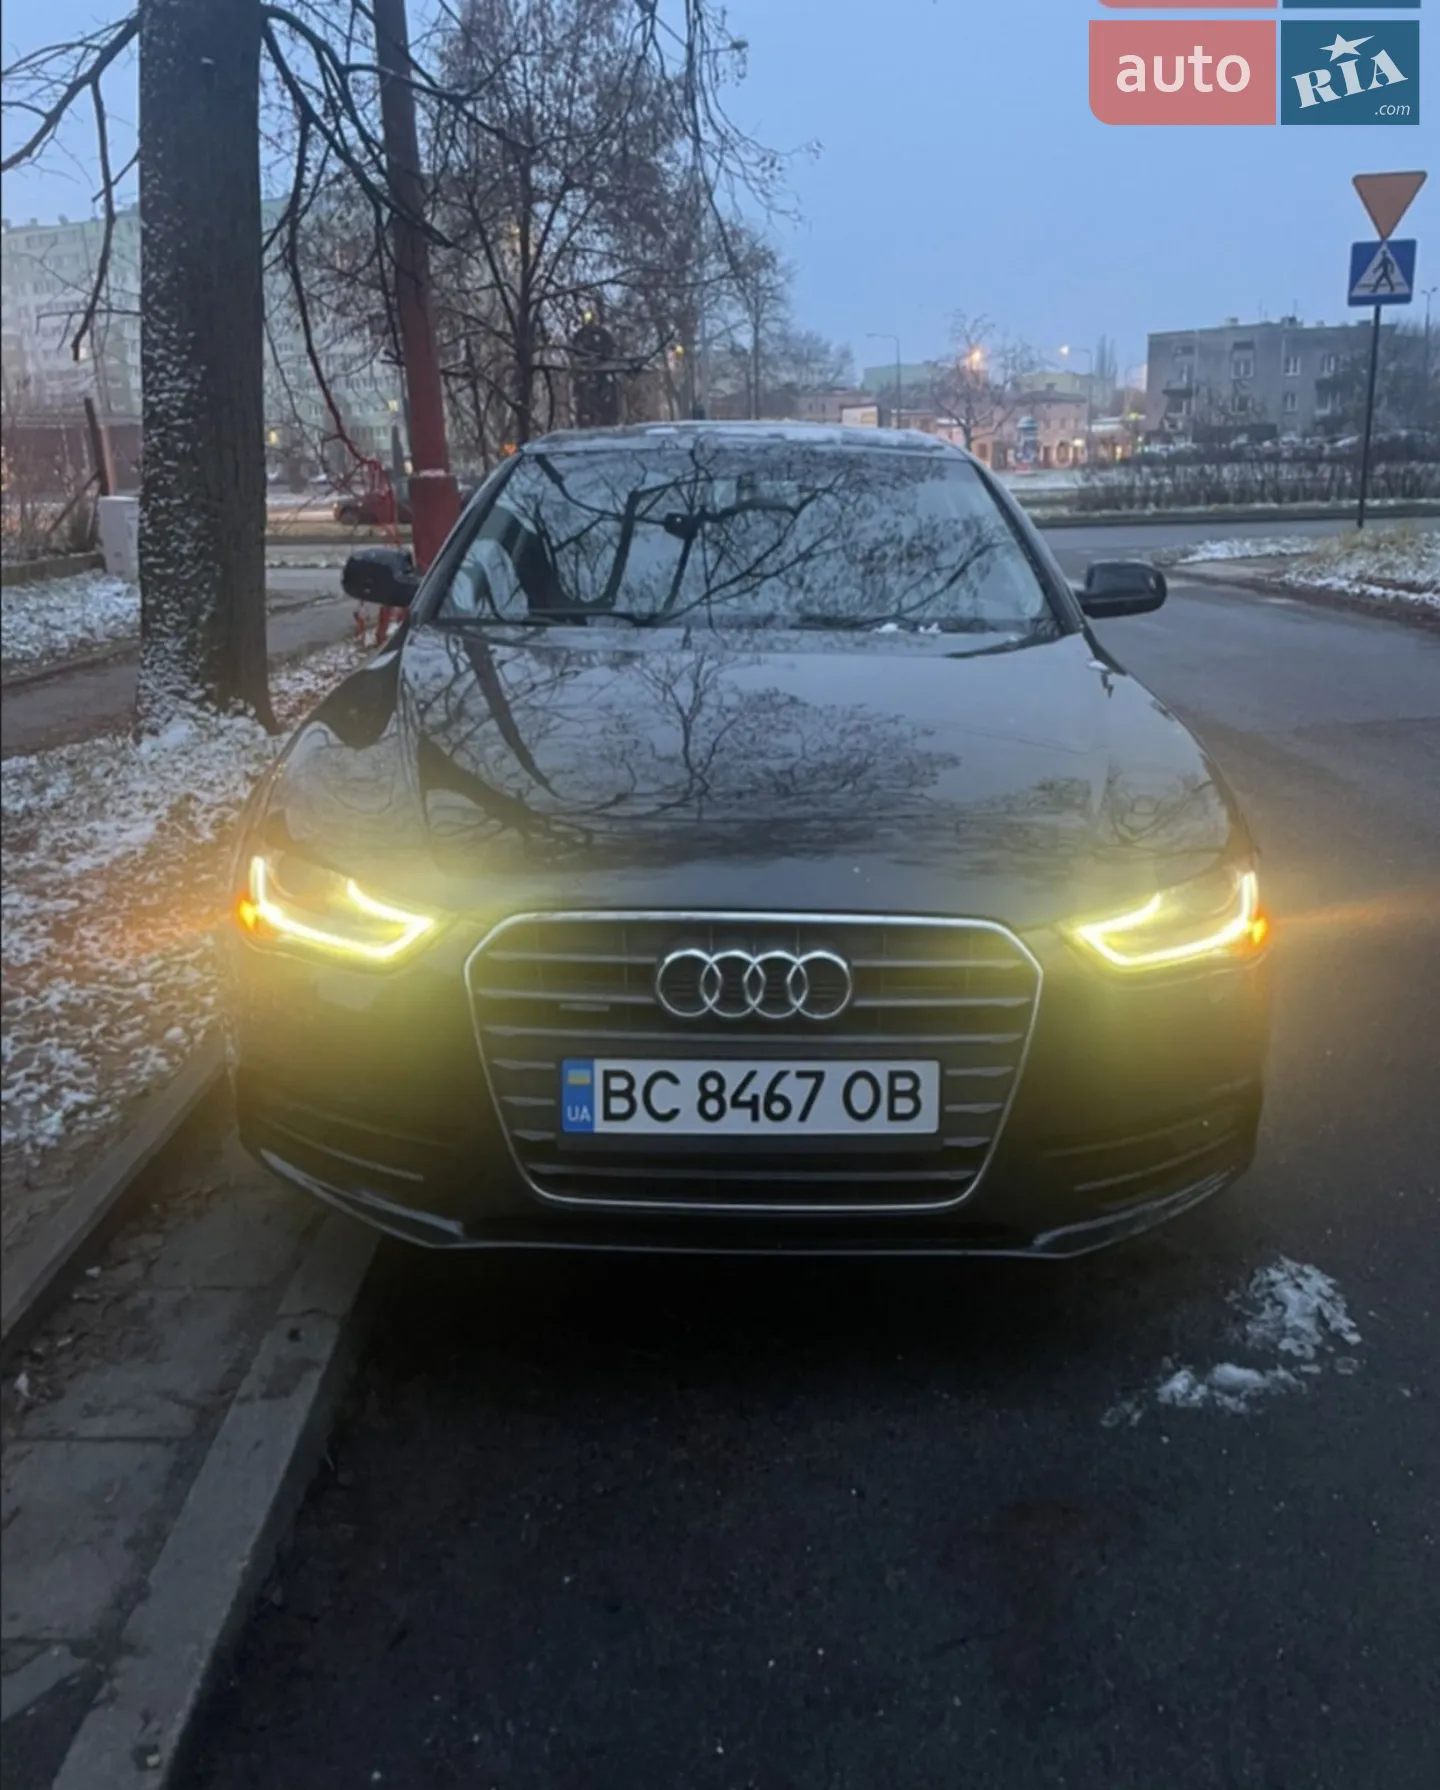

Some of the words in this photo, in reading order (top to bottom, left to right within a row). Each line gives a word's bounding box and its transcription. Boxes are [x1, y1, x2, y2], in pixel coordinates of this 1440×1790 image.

[567, 1105, 592, 1123] UA
[602, 1069, 682, 1123] BC
[696, 1069, 826, 1123] 8467
[842, 1069, 923, 1123] OB
